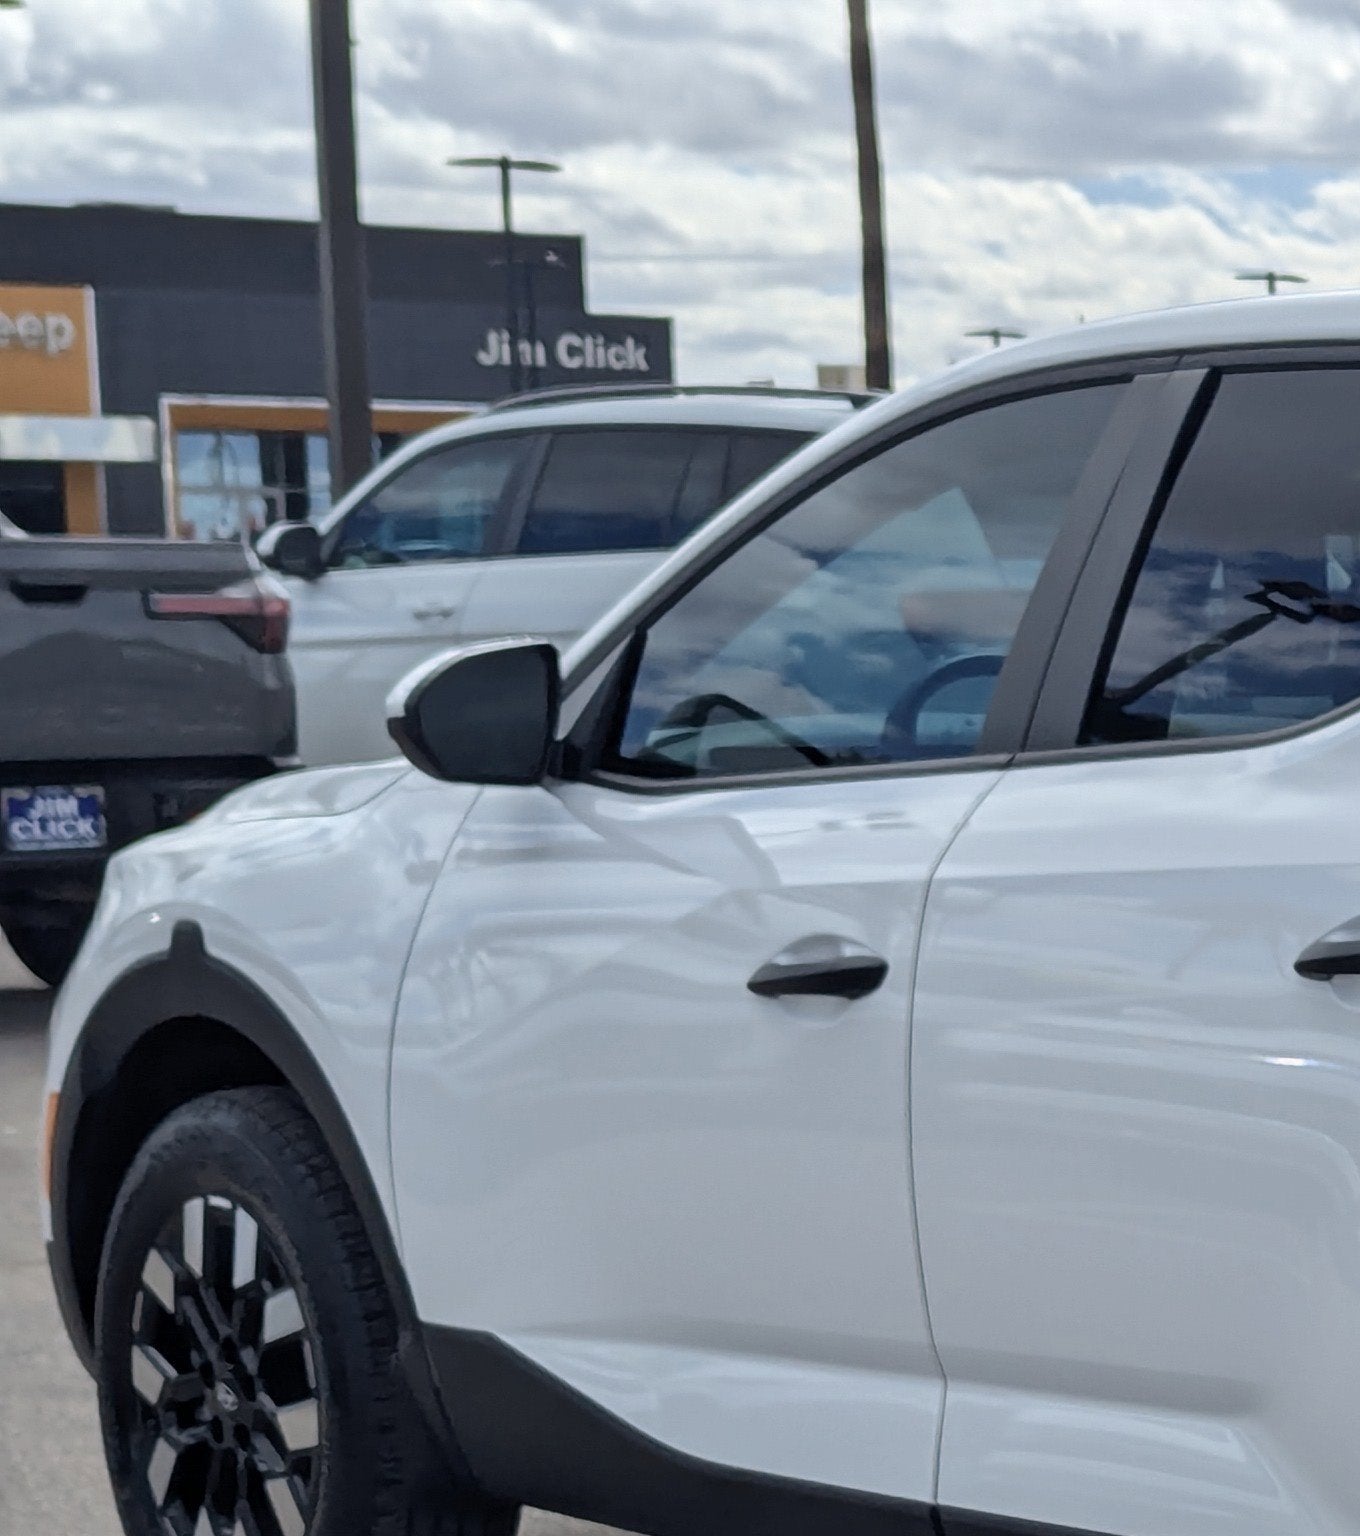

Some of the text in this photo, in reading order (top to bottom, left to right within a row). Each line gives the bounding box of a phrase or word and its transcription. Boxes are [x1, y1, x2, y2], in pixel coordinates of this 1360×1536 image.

[0, 312, 75, 358] eep
[476, 328, 649, 372] Jim Click
[10, 817, 98, 840] CLICK
